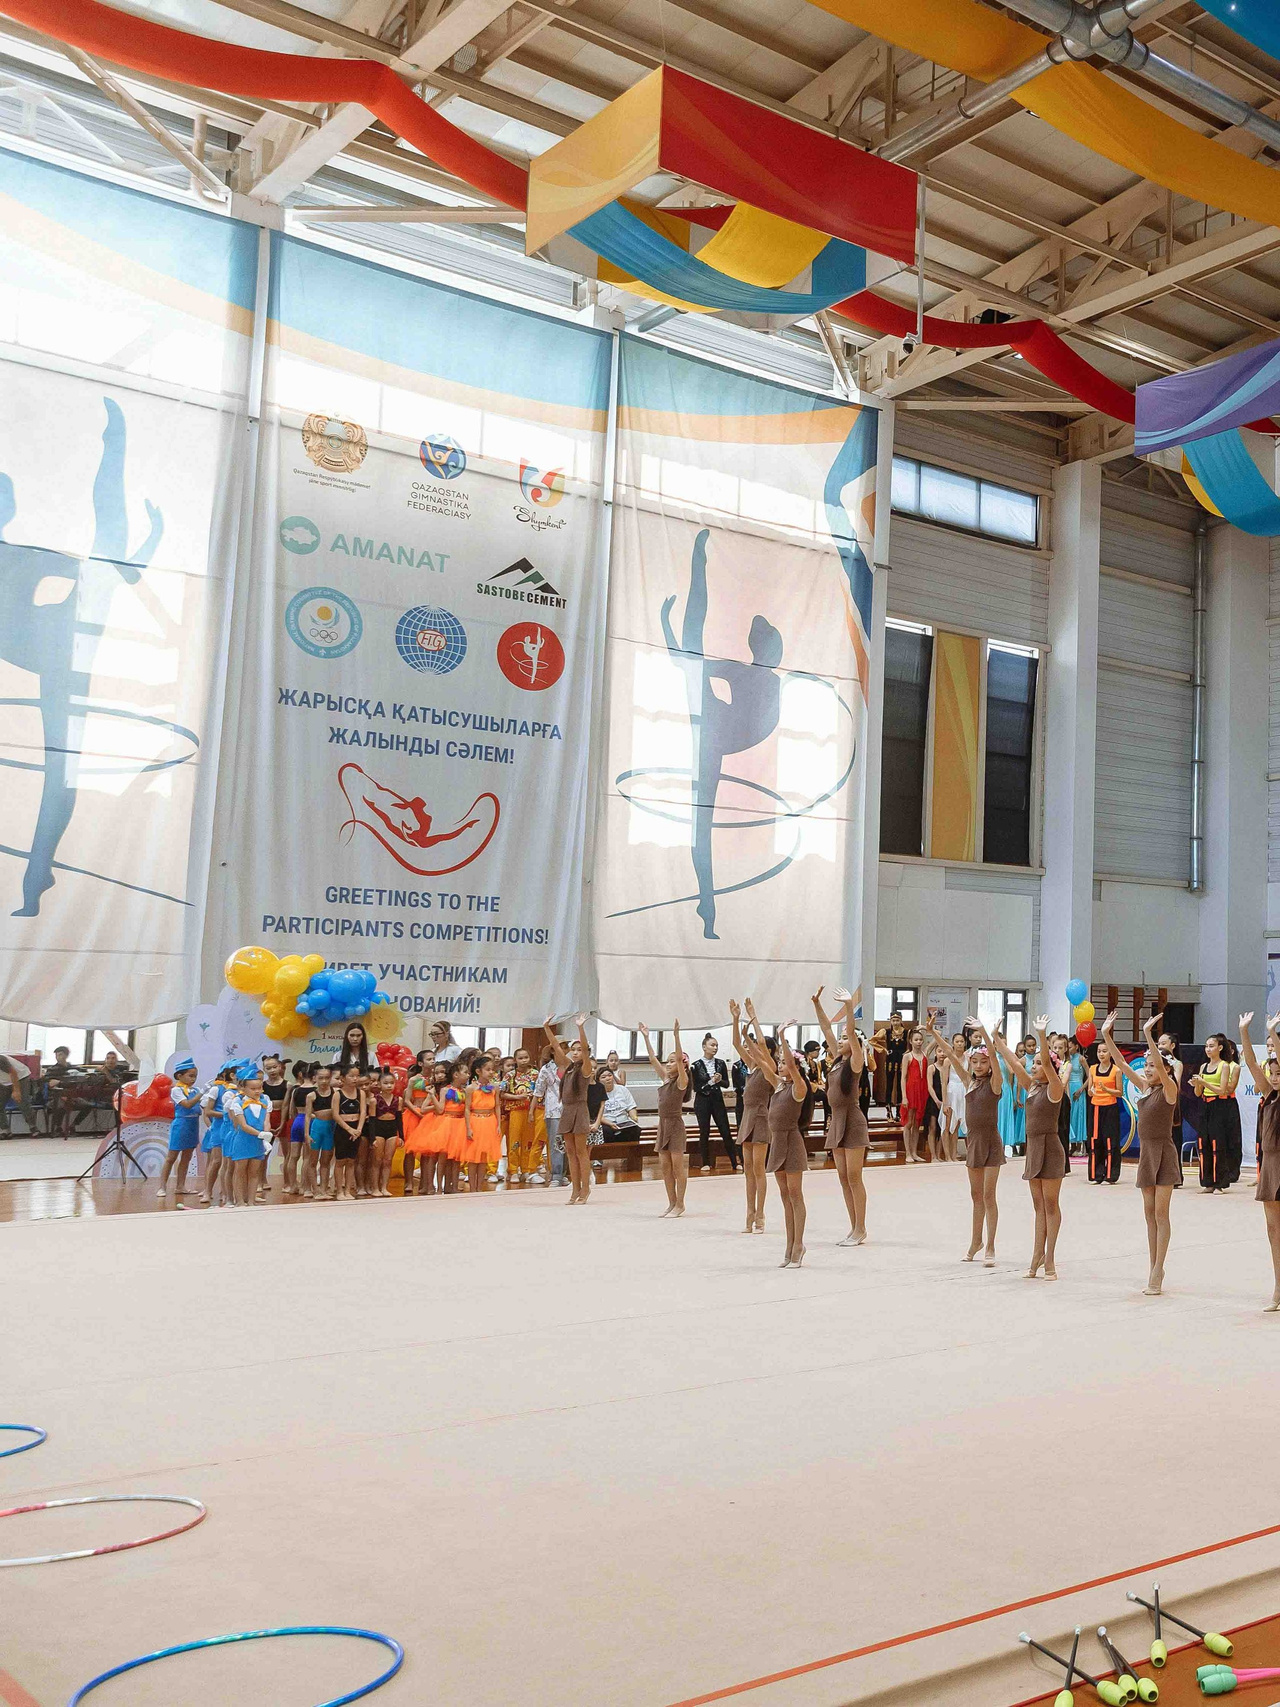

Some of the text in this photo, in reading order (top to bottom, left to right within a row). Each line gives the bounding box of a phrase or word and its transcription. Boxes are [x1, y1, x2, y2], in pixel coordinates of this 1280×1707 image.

[410, 491, 469, 510] GIMNASTIKA
[411, 482, 469, 501] QAZAQSTAN
[407, 501, 472, 521] FEDERACIASY
[329, 533, 450, 573] AMANAT
[278, 687, 562, 740] ЖАРЫСҚА ҚАТЫСУШЫЛАРҒА
[328, 726, 515, 765] ЖАЛЫНДЫ СӘЛЕМ!
[325, 885, 500, 912] GREETINGS TO THE
[262, 914, 549, 945] PARTICIPANTS COMPETITIONS!
[379, 963, 508, 984] УЧАСТНИКАМ
